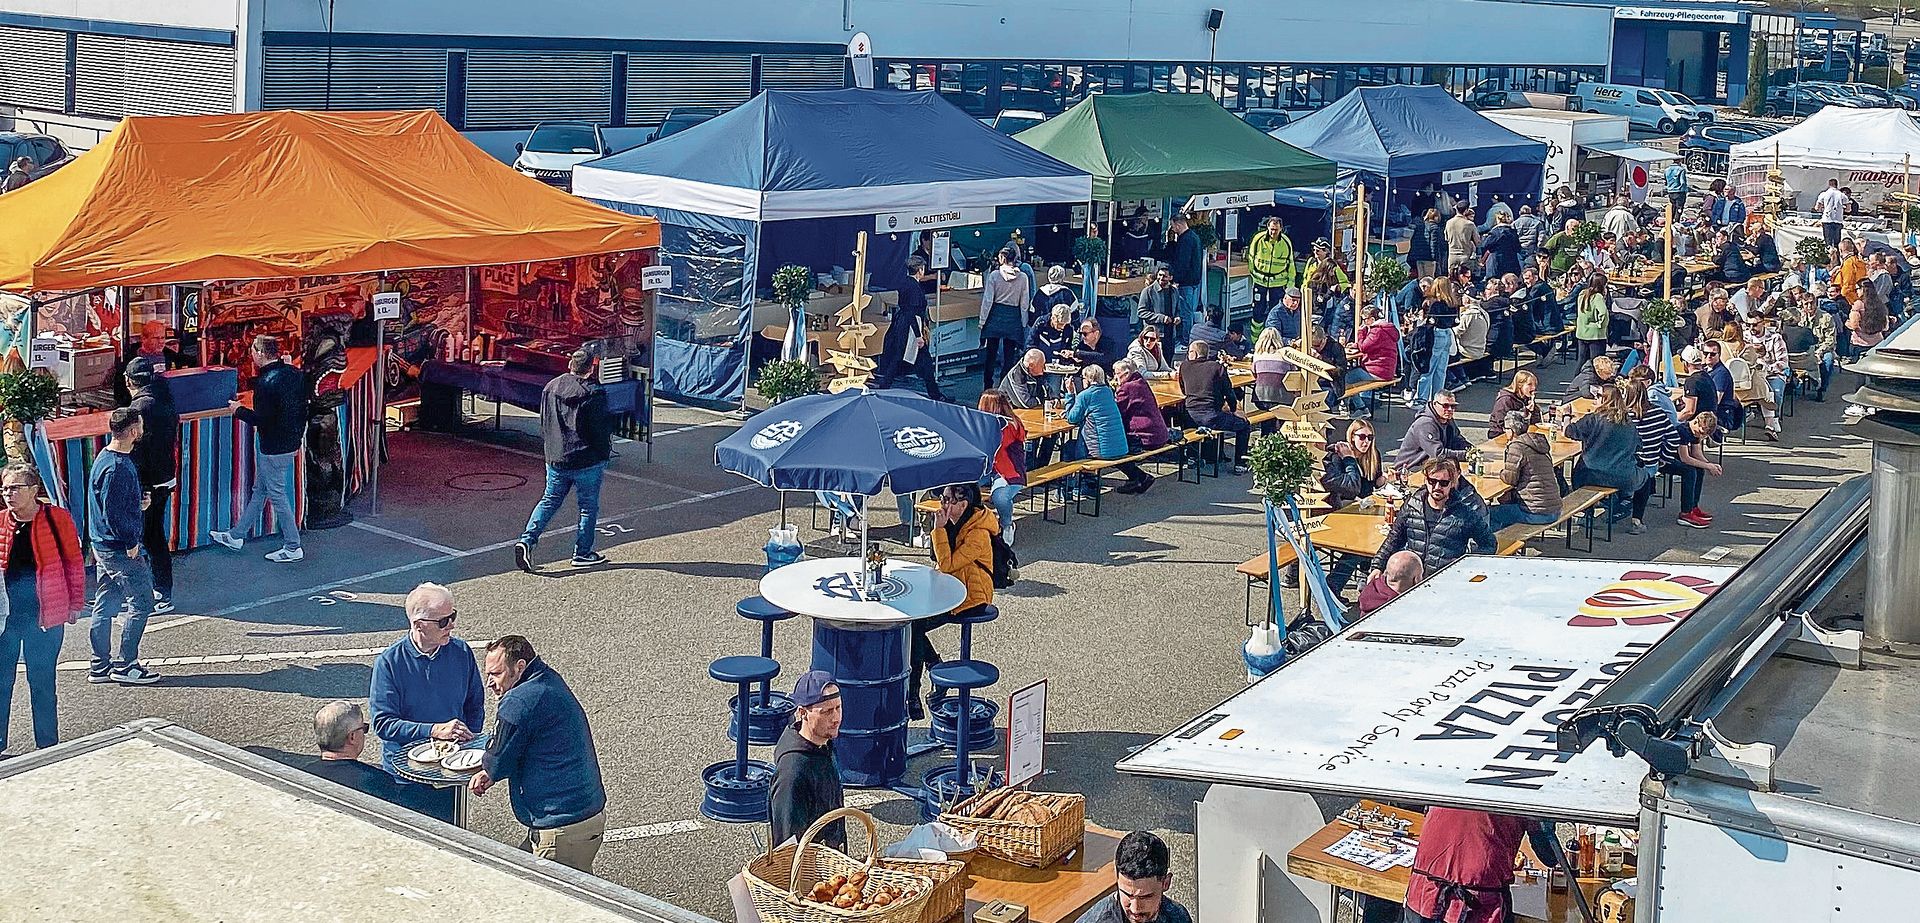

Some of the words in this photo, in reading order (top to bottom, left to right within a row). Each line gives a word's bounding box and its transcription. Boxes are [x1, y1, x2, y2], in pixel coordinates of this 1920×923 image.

[1640, 9, 1725, 20] Fahrzeug-Pflegecenter
[1594, 87, 1623, 98] Hertz
[1226, 194, 1249, 205] GETRÄNKE
[914, 211, 961, 225] RACLETTESTÜBLI
[300, 276, 341, 291] PLACE
[484, 268, 515, 286] PLACE
[1434, 660, 1495, 689] Pizza
[1382, 690, 1450, 722] Party
[1414, 664, 1578, 741] PIZZA
[1317, 724, 1400, 772] Service
